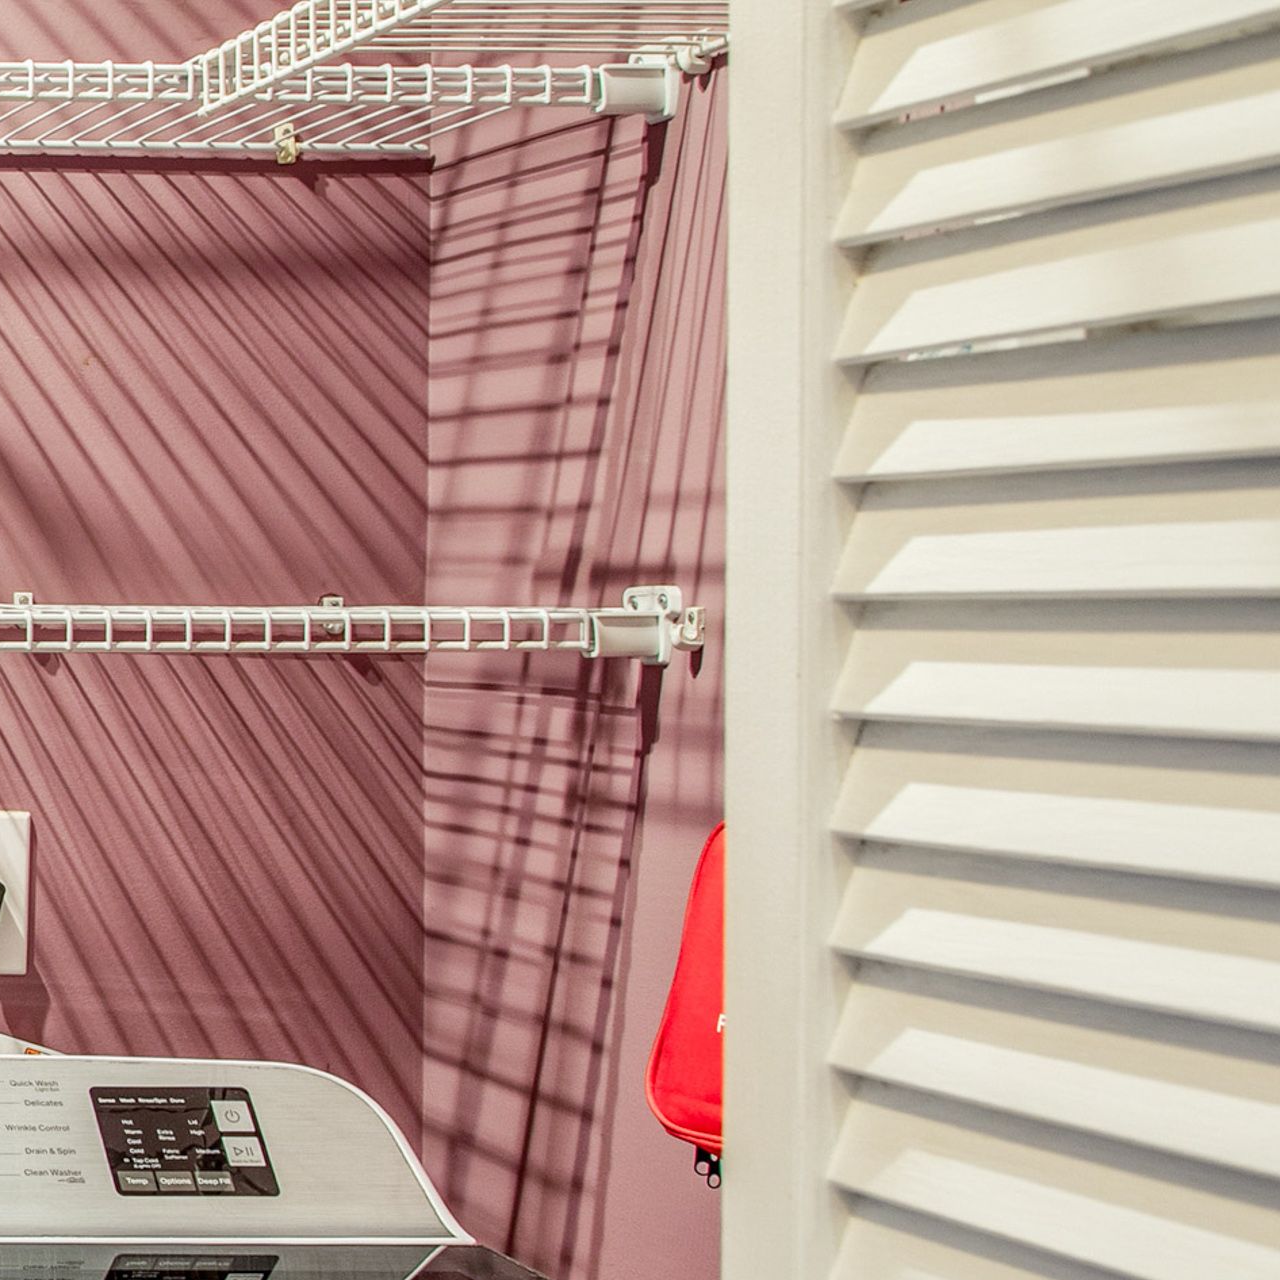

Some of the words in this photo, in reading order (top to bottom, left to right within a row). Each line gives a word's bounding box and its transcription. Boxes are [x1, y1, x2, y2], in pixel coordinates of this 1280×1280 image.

[38, 1124, 70, 1132] Control
[24, 1147, 48, 1155] Drain
[56, 1147, 77, 1156] Spin
[125, 1176, 149, 1185] Temp
[159, 1177, 192, 1186] Options
